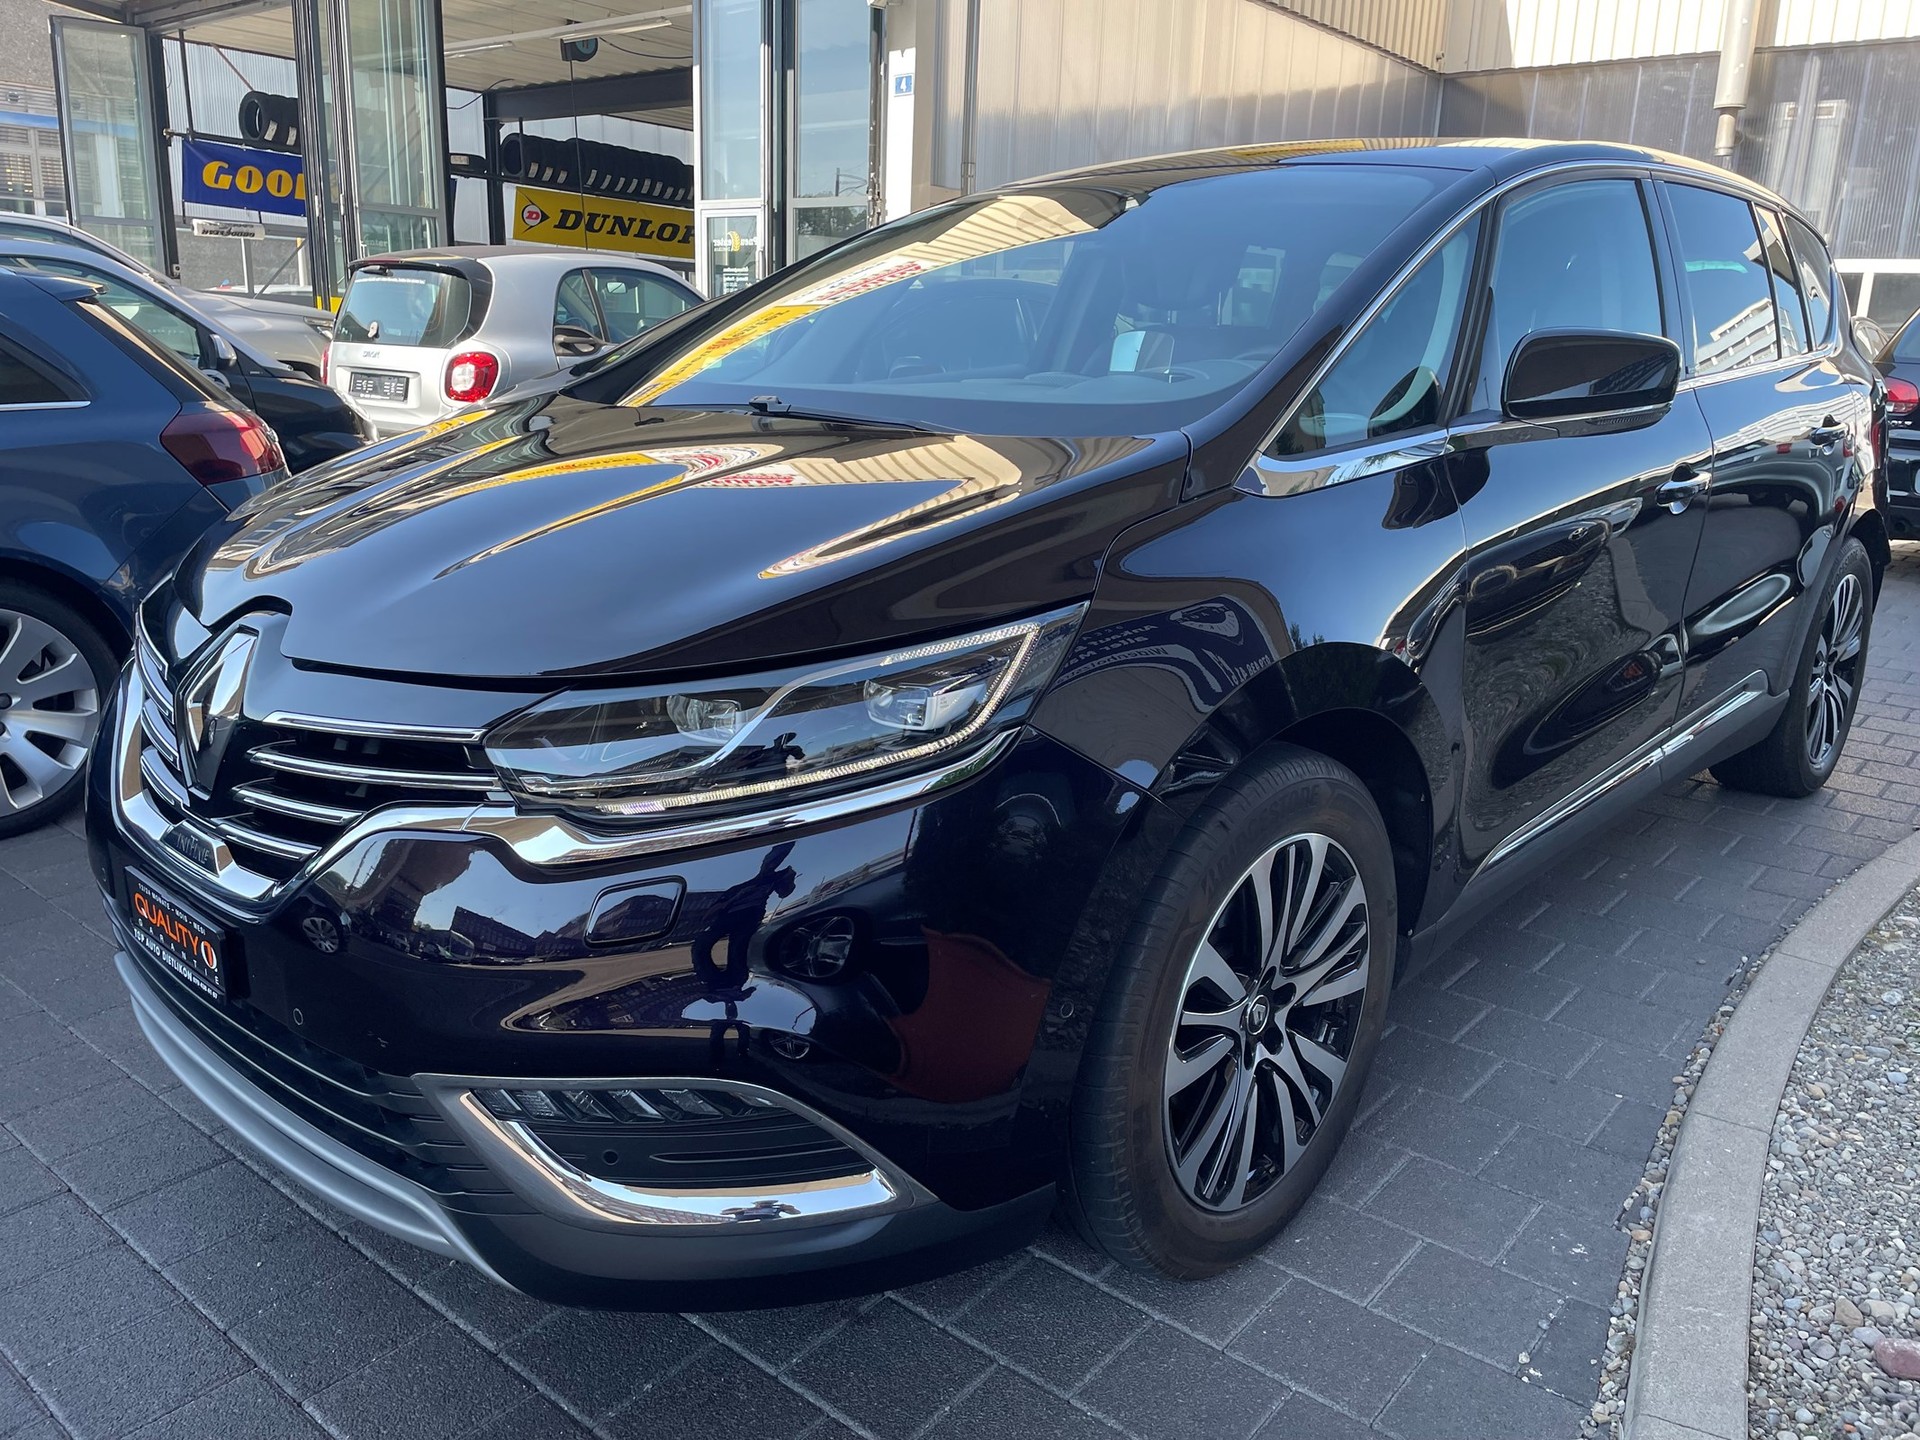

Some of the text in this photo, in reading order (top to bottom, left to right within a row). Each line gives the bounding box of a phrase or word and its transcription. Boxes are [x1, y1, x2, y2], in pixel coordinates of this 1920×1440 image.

[134, 892, 199, 956] QUALITY
[133, 928, 145, 943] TOP
[145, 938, 160, 957] AUTO
[162, 951, 193, 983] DIETLIKON
